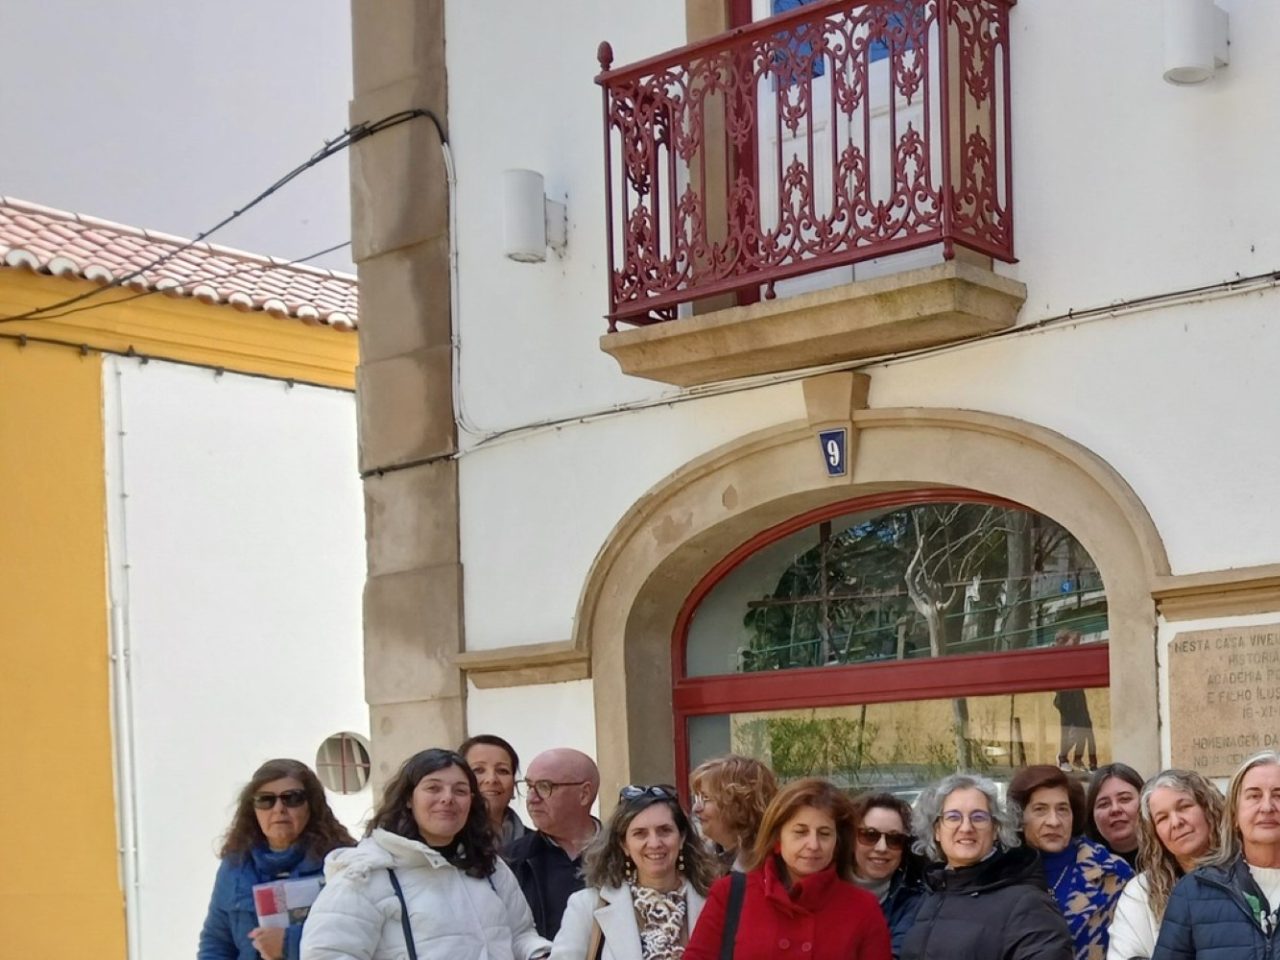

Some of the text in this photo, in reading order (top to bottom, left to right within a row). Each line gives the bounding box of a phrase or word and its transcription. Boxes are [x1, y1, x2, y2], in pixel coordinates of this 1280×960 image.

[827, 439, 840, 467] 9
[1174, 640, 1210, 653] NESTA
[1215, 634, 1245, 649] CASA
[1193, 734, 1260, 750] HOMENAGEM
[1264, 733, 1279, 747] DA
